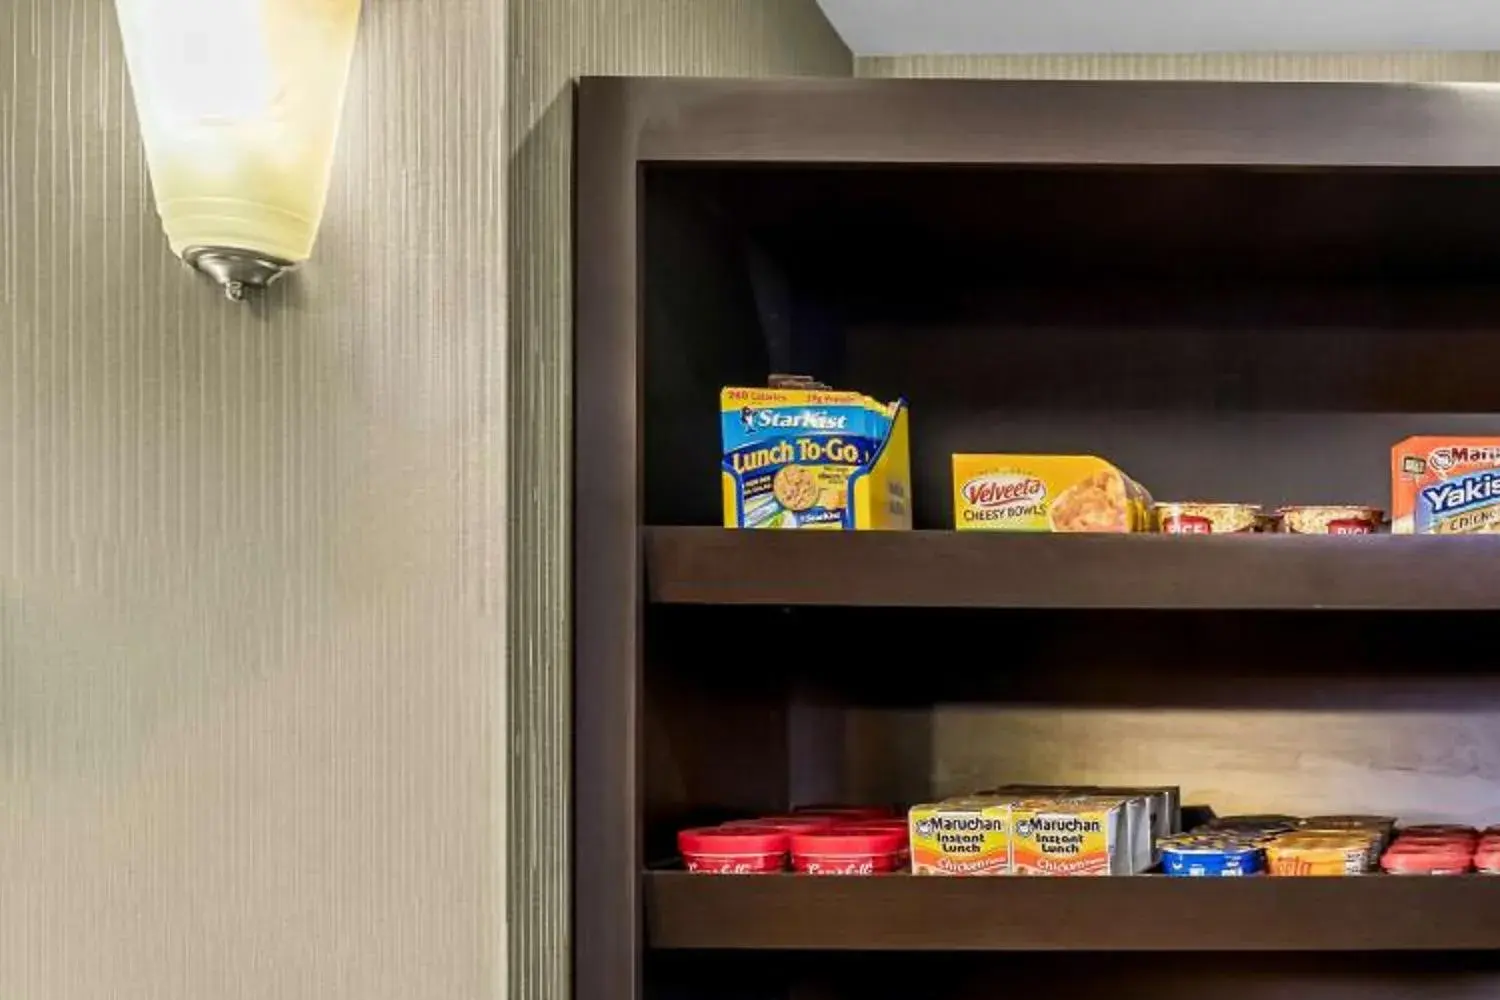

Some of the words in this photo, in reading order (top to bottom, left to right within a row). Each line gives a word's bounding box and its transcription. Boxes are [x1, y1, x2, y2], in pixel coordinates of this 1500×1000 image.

[758, 408, 848, 430] StarKist
[733, 440, 795, 473] Lunch
[969, 478, 1042, 505] Velveeta
[964, 508, 1005, 522] CHEESY
[1007, 503, 1047, 519] BOWLS
[930, 816, 1001, 831] Maruchan
[1031, 817, 1100, 832] Maruchan
[937, 833, 985, 844] Instant
[1036, 833, 1084, 844] Instant
[942, 843, 981, 854] Lunch
[1041, 844, 1080, 854] Lunch
